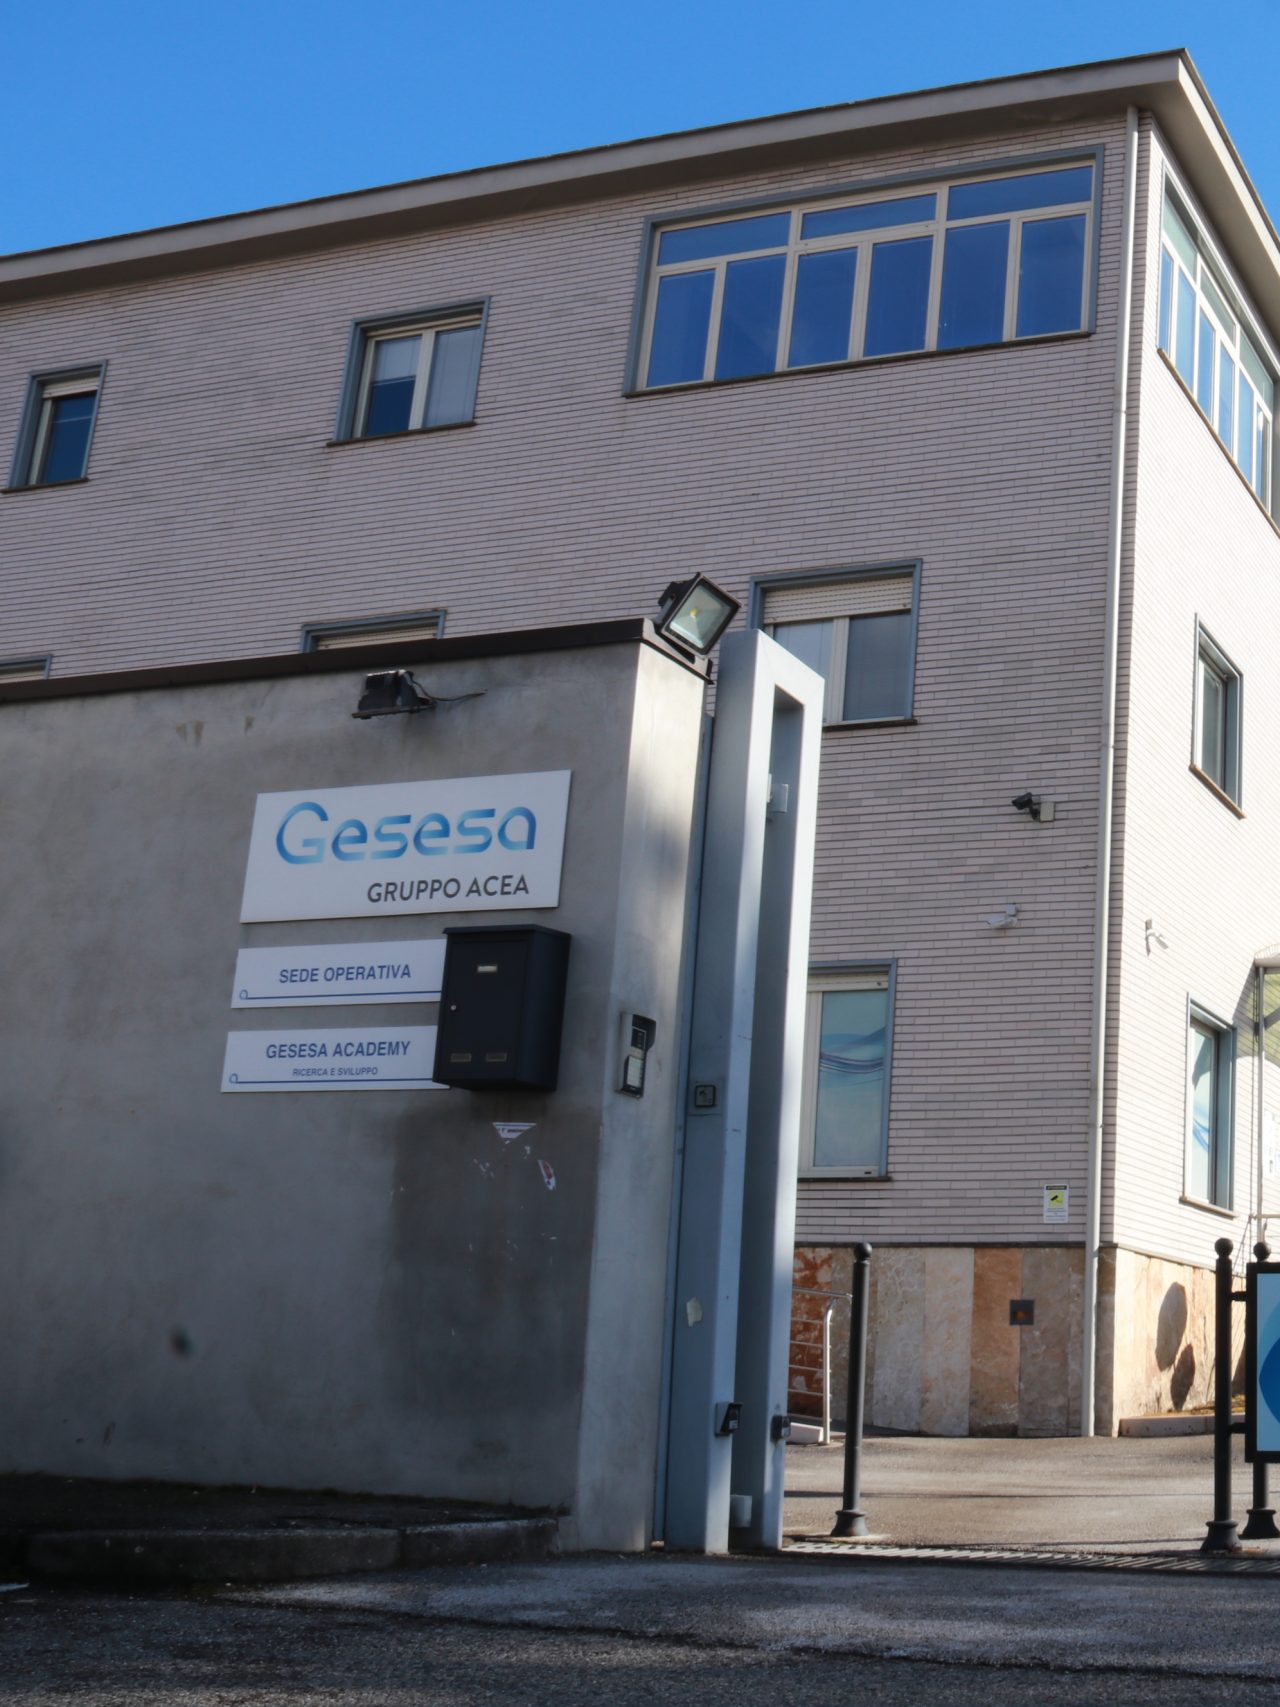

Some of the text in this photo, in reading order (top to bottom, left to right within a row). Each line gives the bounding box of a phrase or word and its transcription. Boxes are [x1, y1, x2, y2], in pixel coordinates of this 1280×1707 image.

[276, 801, 537, 865] Gesesa
[367, 874, 530, 903] GRUPPO ACEA
[279, 963, 412, 984] SEDE OPERATIVA
[266, 1040, 412, 1059] GESESA ACADEMY
[292, 1066, 379, 1077] RICERCA E SVILUPPO
